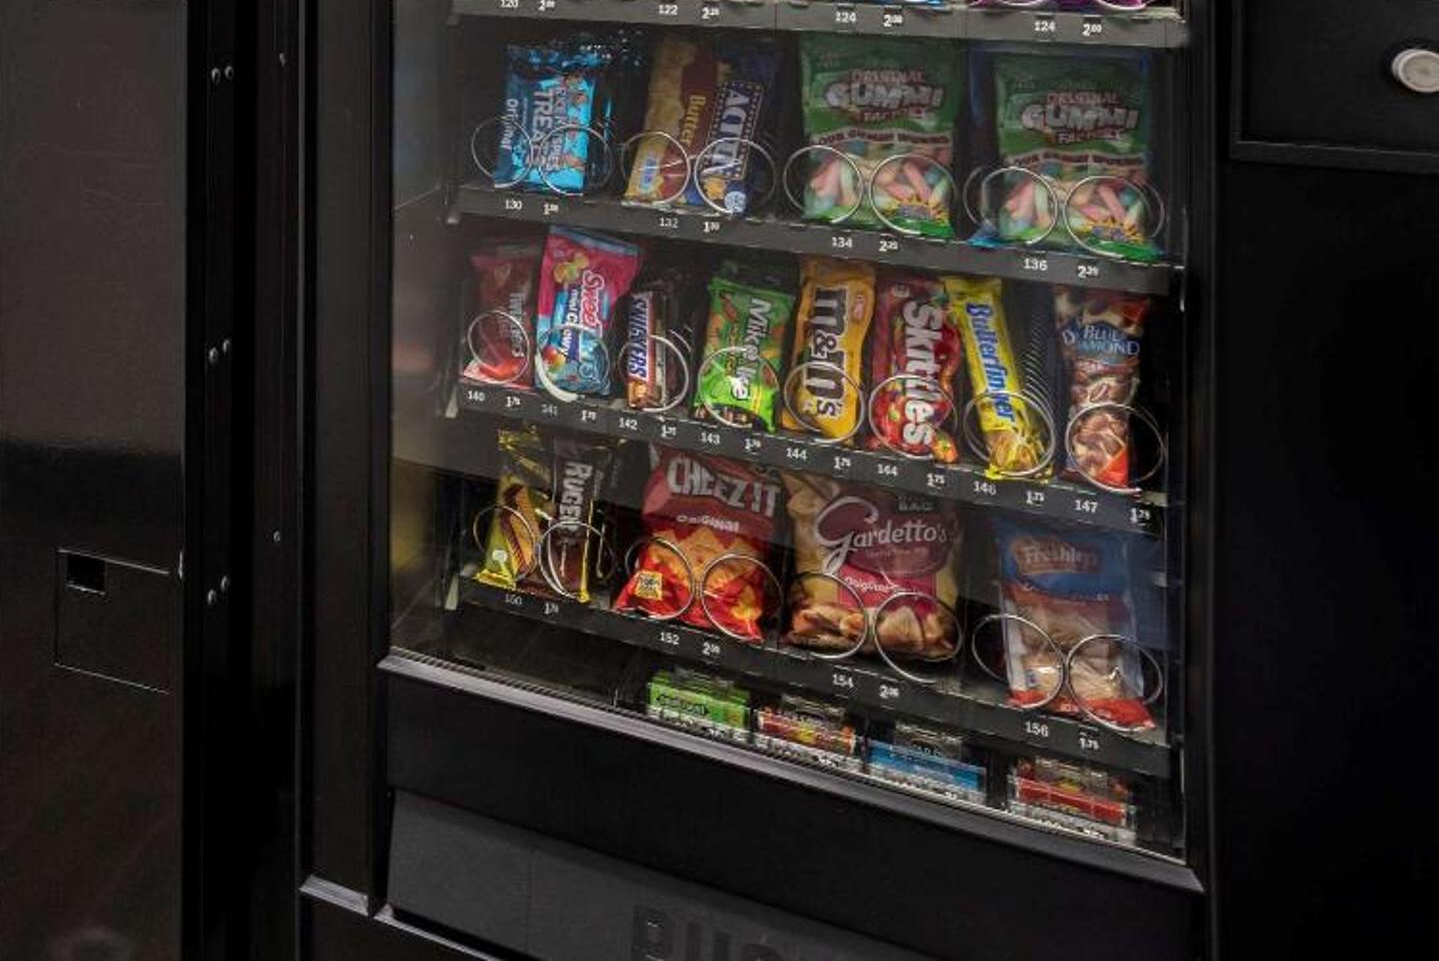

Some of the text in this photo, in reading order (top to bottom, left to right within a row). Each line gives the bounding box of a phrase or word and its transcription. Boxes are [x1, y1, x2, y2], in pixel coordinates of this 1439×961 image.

[1024, 258, 1047, 271] 136
[628, 298, 649, 378] SNICKERS
[1083, 324, 1126, 345] BLUE
[966, 302, 1016, 423] Butterfinger
[901, 300, 944, 447] Skittles
[619, 418, 638, 430] 142
[701, 432, 720, 445] 143
[786, 448, 807, 460] 144
[1075, 500, 1098, 513] 147
[815, 495, 949, 578] Gardetto's
[660, 632, 680, 645] 152
[1025, 721, 1048, 737] 156
